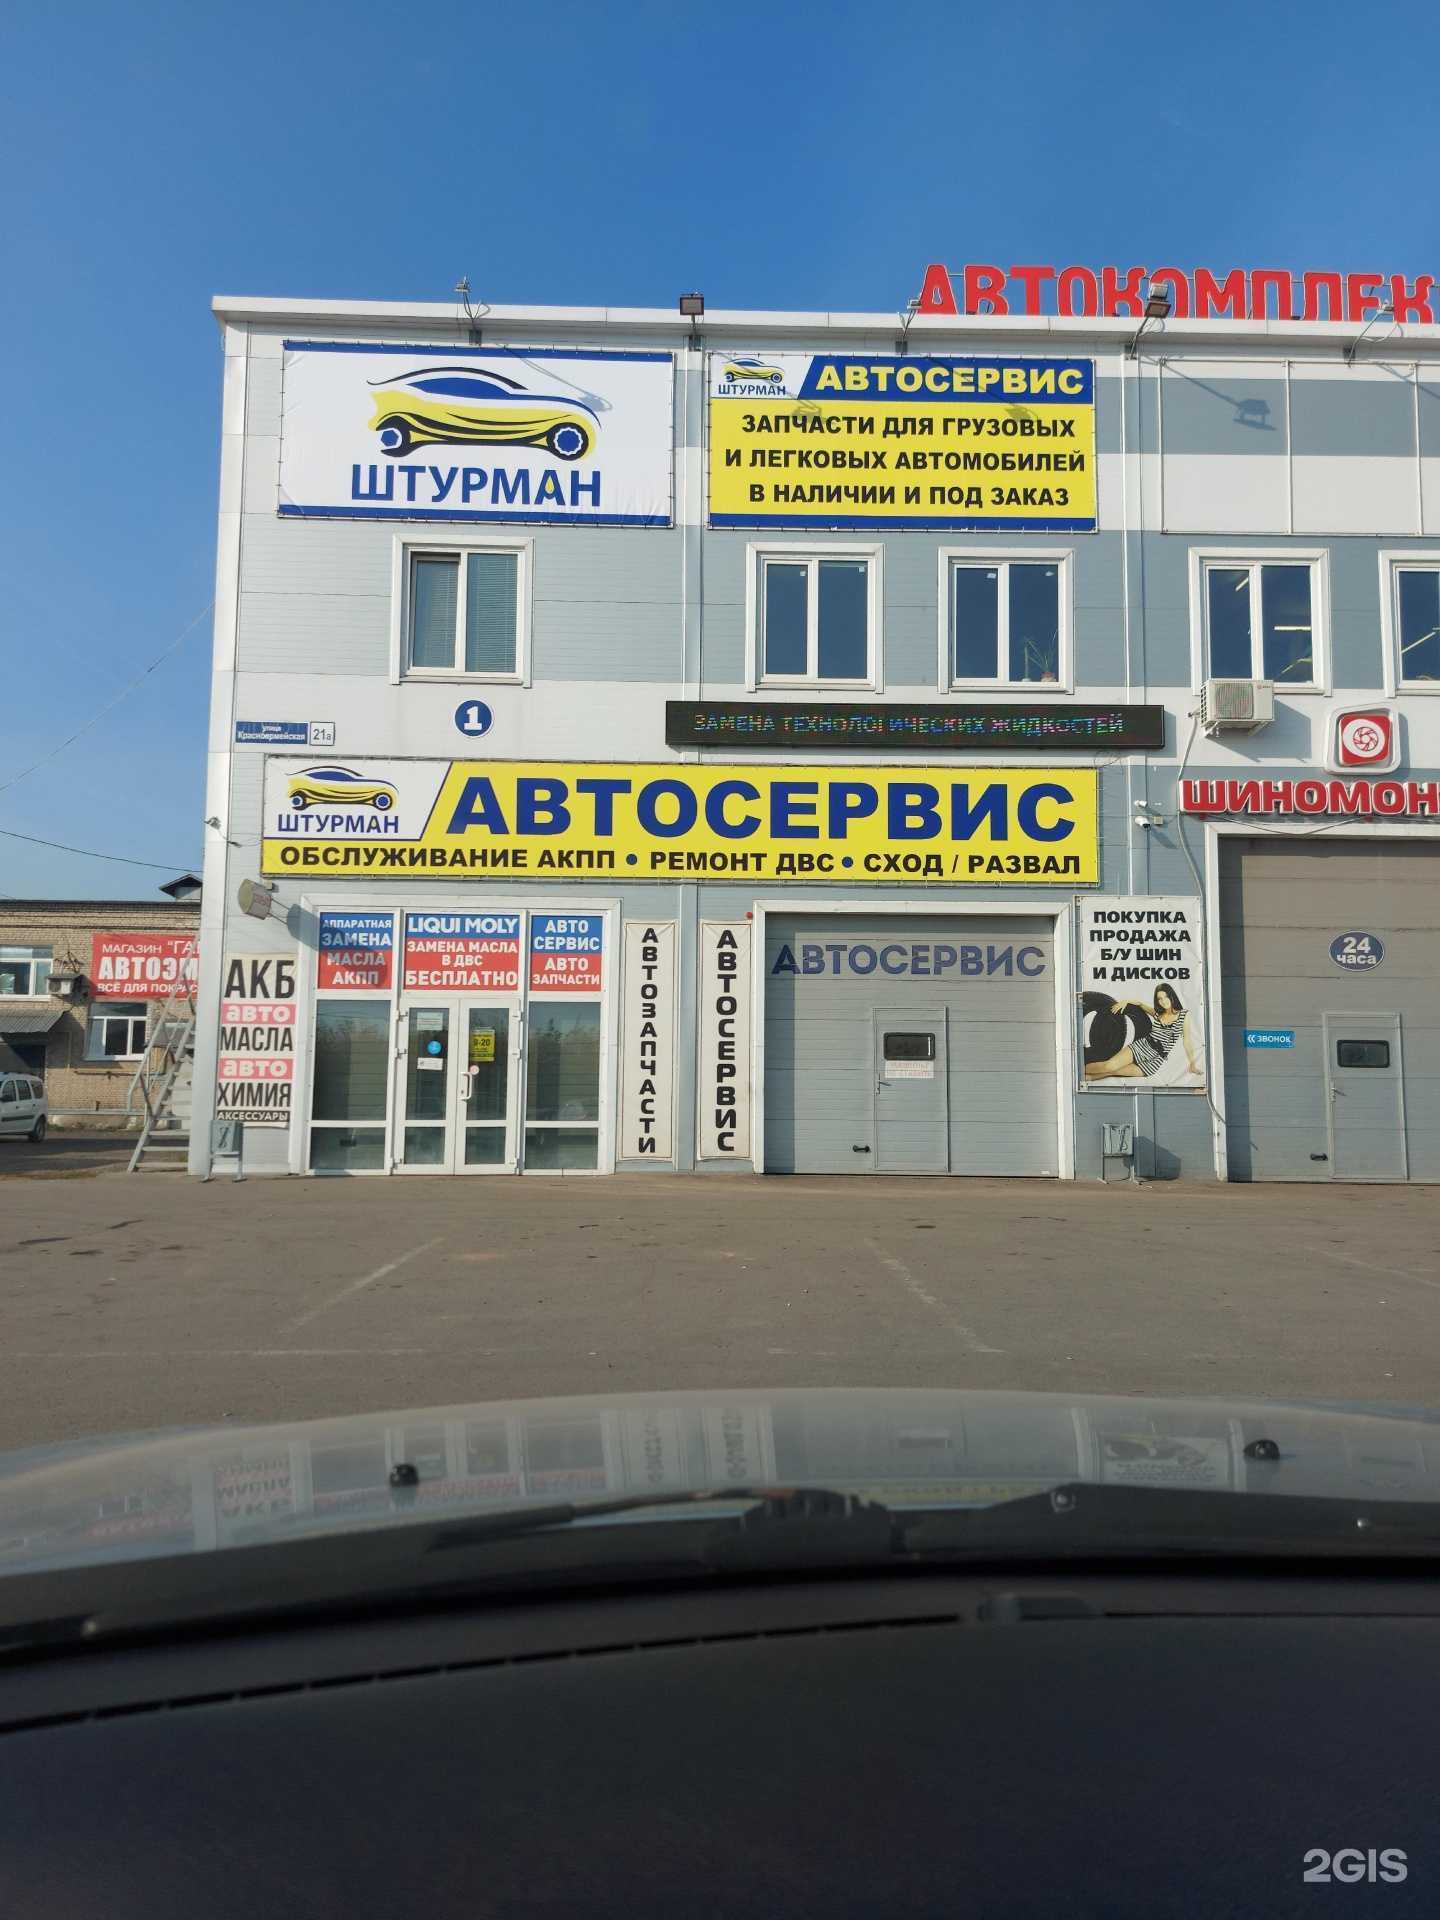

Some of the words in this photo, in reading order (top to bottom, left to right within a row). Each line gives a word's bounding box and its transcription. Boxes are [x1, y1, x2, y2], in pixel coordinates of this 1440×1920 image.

[921, 265, 1435, 323] АВТОКОМПЛЕК
[815, 366, 1084, 394] АВТОСЕРВИС
[718, 382, 786, 397] ШТУРМАН
[742, 415, 875, 436] ЗАПЧАСТИ
[883, 417, 934, 438] ДЛЯ
[942, 418, 1075, 437] ГРУЗОВЫХ
[725, 449, 742, 467] И
[749, 449, 888, 469] ЛЕГКОВЫХ
[895, 450, 1085, 472] АВТОМОБИЛЕЙ
[351, 464, 600, 507] ШТУРМАН
[749, 485, 765, 502] В
[774, 485, 895, 504] НАЛИЧИИ
[904, 486, 921, 504] И
[930, 486, 983, 508] ПОД
[991, 487, 1069, 506] ЗАКАЗ
[464, 706, 482, 730] 1
[694, 715, 775, 731] ЗАМЕНА
[991, 713, 1123, 736] ЖИДКОСТЕЙ
[1179, 779, 1439, 815] ШИНОМОН
[446, 777, 1076, 842] АВТОСЕРВИС
[277, 813, 399, 834] ШТУРМАН
[280, 846, 528, 868] ОБСЛУЖИВАНИЕ
[537, 849, 615, 869] АКПП
[651, 851, 767, 872] РЕМОНТ
[776, 853, 834, 875] ДВС
[864, 853, 944, 876] СХОД
[968, 854, 1080, 875] РАЗВАЛ
[322, 919, 392, 929] АППАРАТНАЯ
[408, 917, 461, 935] LIQUI
[465, 918, 518, 934] MOLY
[1093, 911, 1186, 924] ПОКУПКА
[545, 920, 589, 934] АВТО
[322, 933, 392, 947] ЗАМЕНА
[534, 936, 600, 951] СЕРВИС
[1089, 930, 1191, 944] ПРОДАЖА
[1343, 936, 1371, 954] 24
[102, 944, 162, 954] МАГАЗИН
[407, 941, 464, 953] ЗАМЕНА
[469, 942, 518, 954] МАСЛА
[1101, 948, 1131, 960] Б/У
[1136, 949, 1181, 960] ШИН
[327, 953, 386, 966] МАСЛА
[442, 954, 452, 967] В
[455, 955, 483, 969] ДВС
[545, 957, 589, 971] АВТО
[771, 944, 1046, 977] АВТОСЕРВИС
[1336, 954, 1377, 965] часа
[224, 959, 295, 999] АКБ
[332, 971, 379, 985] АКПП
[405, 970, 518, 987] БЕСПЛАТНО
[532, 974, 600, 986] ЗАПЧАСТИ
[1093, 967, 1107, 979] И
[1111, 967, 1190, 981] ДИСКОВ
[123, 983, 148, 994] ДЛЯ
[226, 1005, 290, 1023] авто
[221, 1027, 293, 1051] МАСЛА
[638, 928, 659, 1153] АВТОЗАПЧАСТИ
[715, 930, 738, 1151] АВТОСЕРВИС
[1256, 1035, 1292, 1044] ЗВОНОК
[223, 1060, 287, 1077] авто
[217, 1082, 291, 1108] ХИМИЯ
[217, 1111, 288, 1121] АКСЕССУАРЫ
